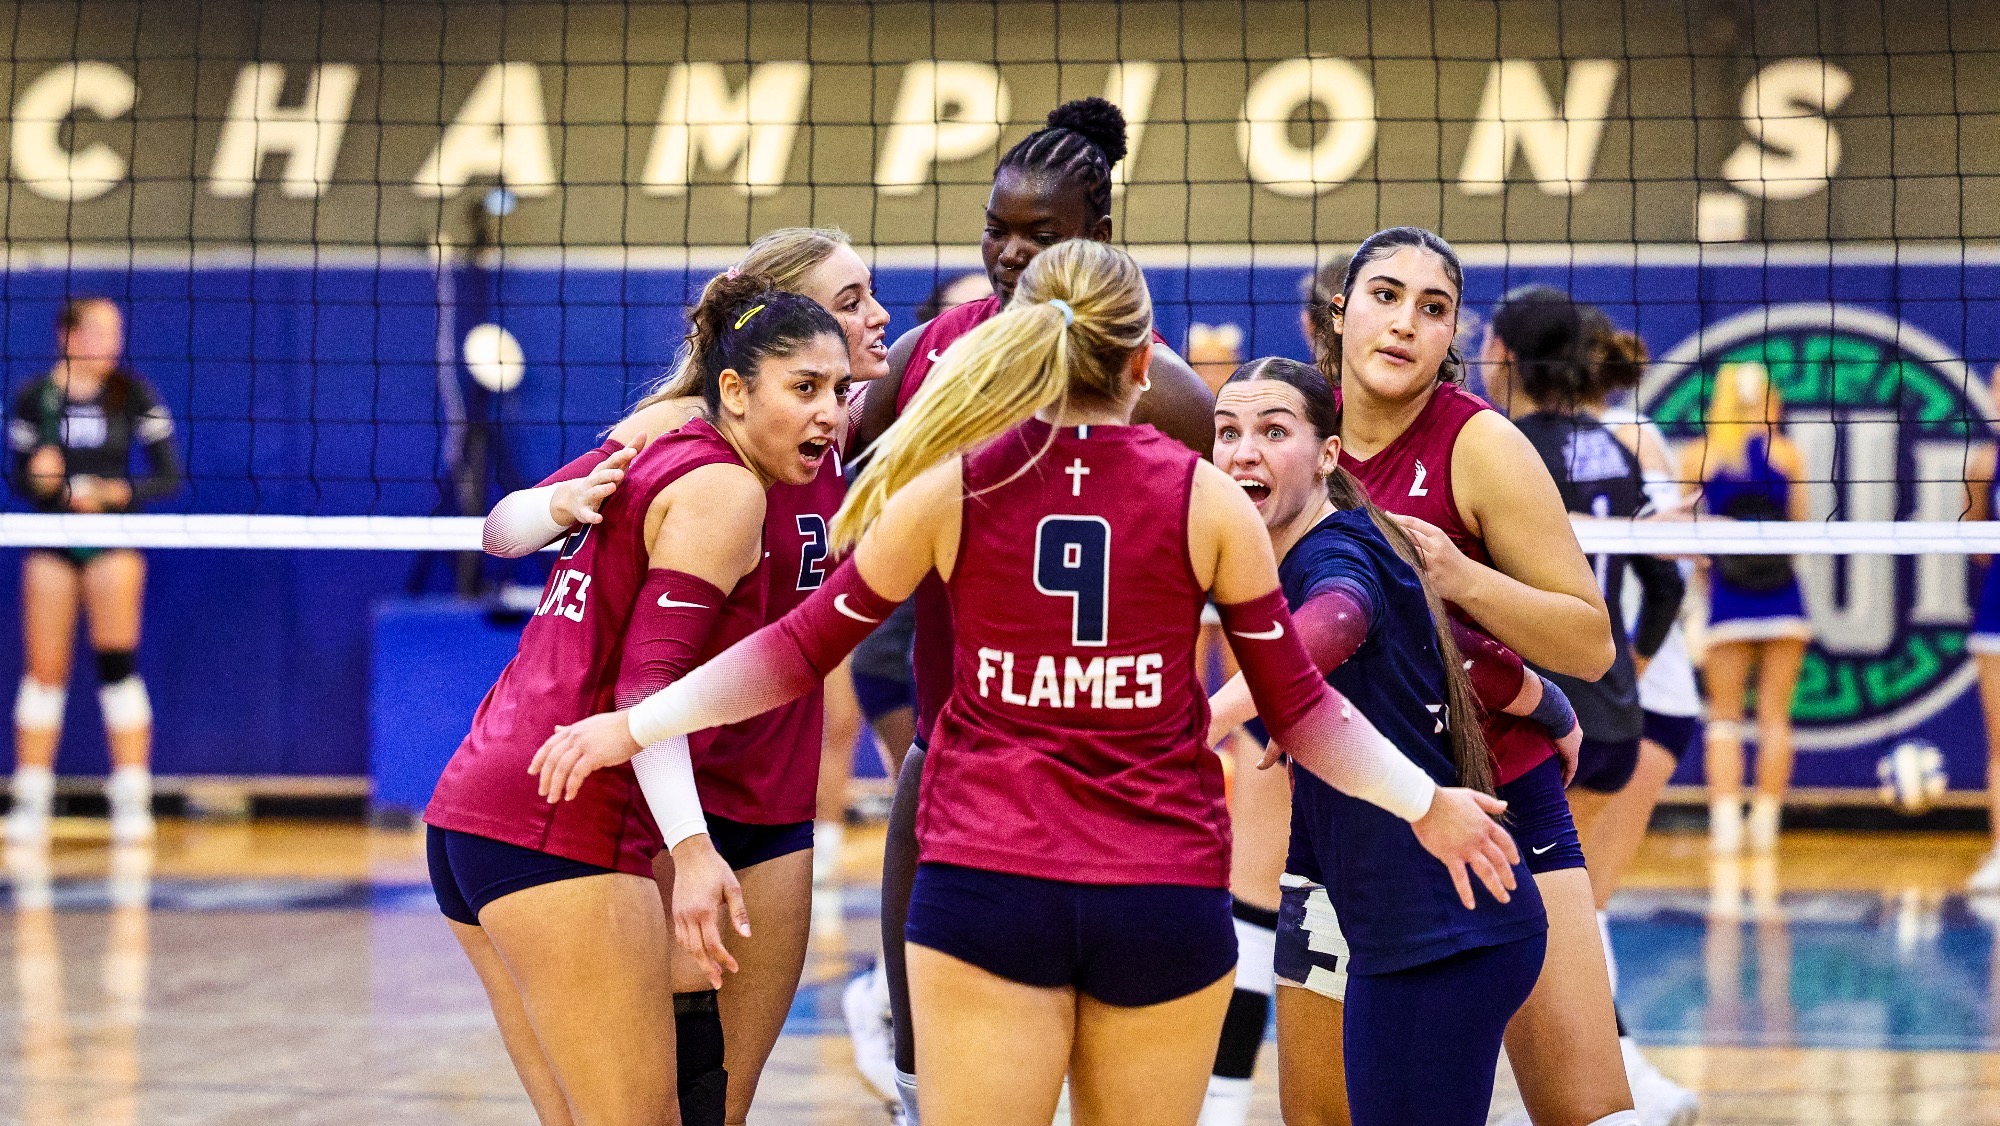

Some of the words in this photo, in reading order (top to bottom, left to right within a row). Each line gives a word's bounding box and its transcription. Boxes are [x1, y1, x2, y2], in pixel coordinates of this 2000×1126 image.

[8, 57, 1854, 201] CHAMPIONS
[795, 513, 830, 592] 2
[1033, 513, 1112, 647] 9
[977, 646, 1164, 710] FLAMES
